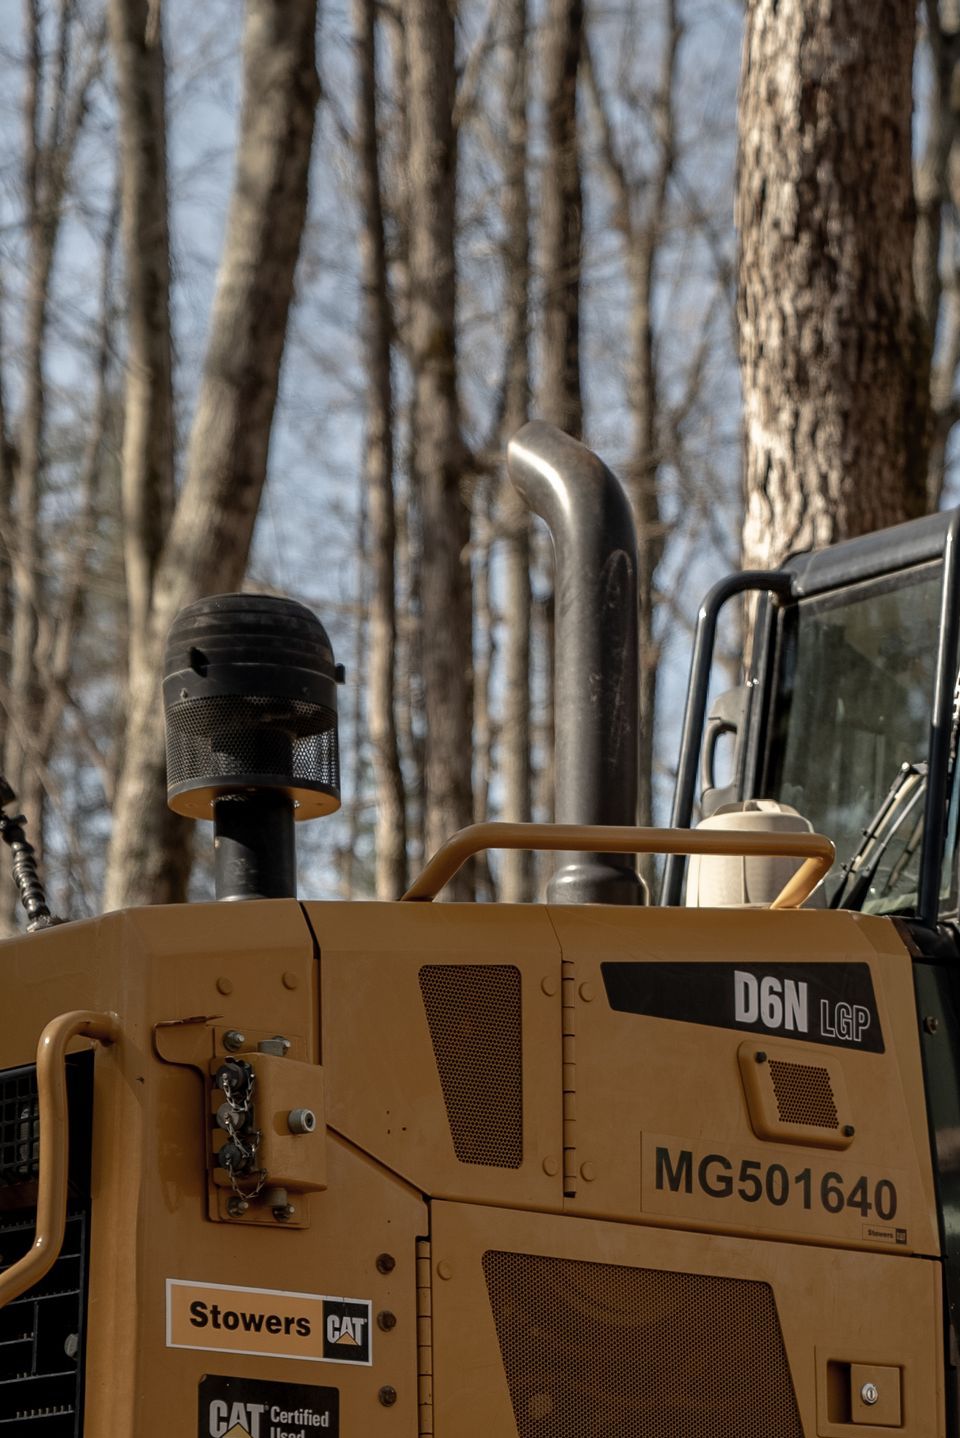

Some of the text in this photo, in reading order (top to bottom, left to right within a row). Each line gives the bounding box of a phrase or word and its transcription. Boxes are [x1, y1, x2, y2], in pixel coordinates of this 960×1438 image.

[733, 970, 871, 1042] D6N LGP
[655, 1146, 898, 1221] MG501640
[189, 1301, 366, 1346] Stowers CAT
[270, 1406, 329, 1428] Certified
